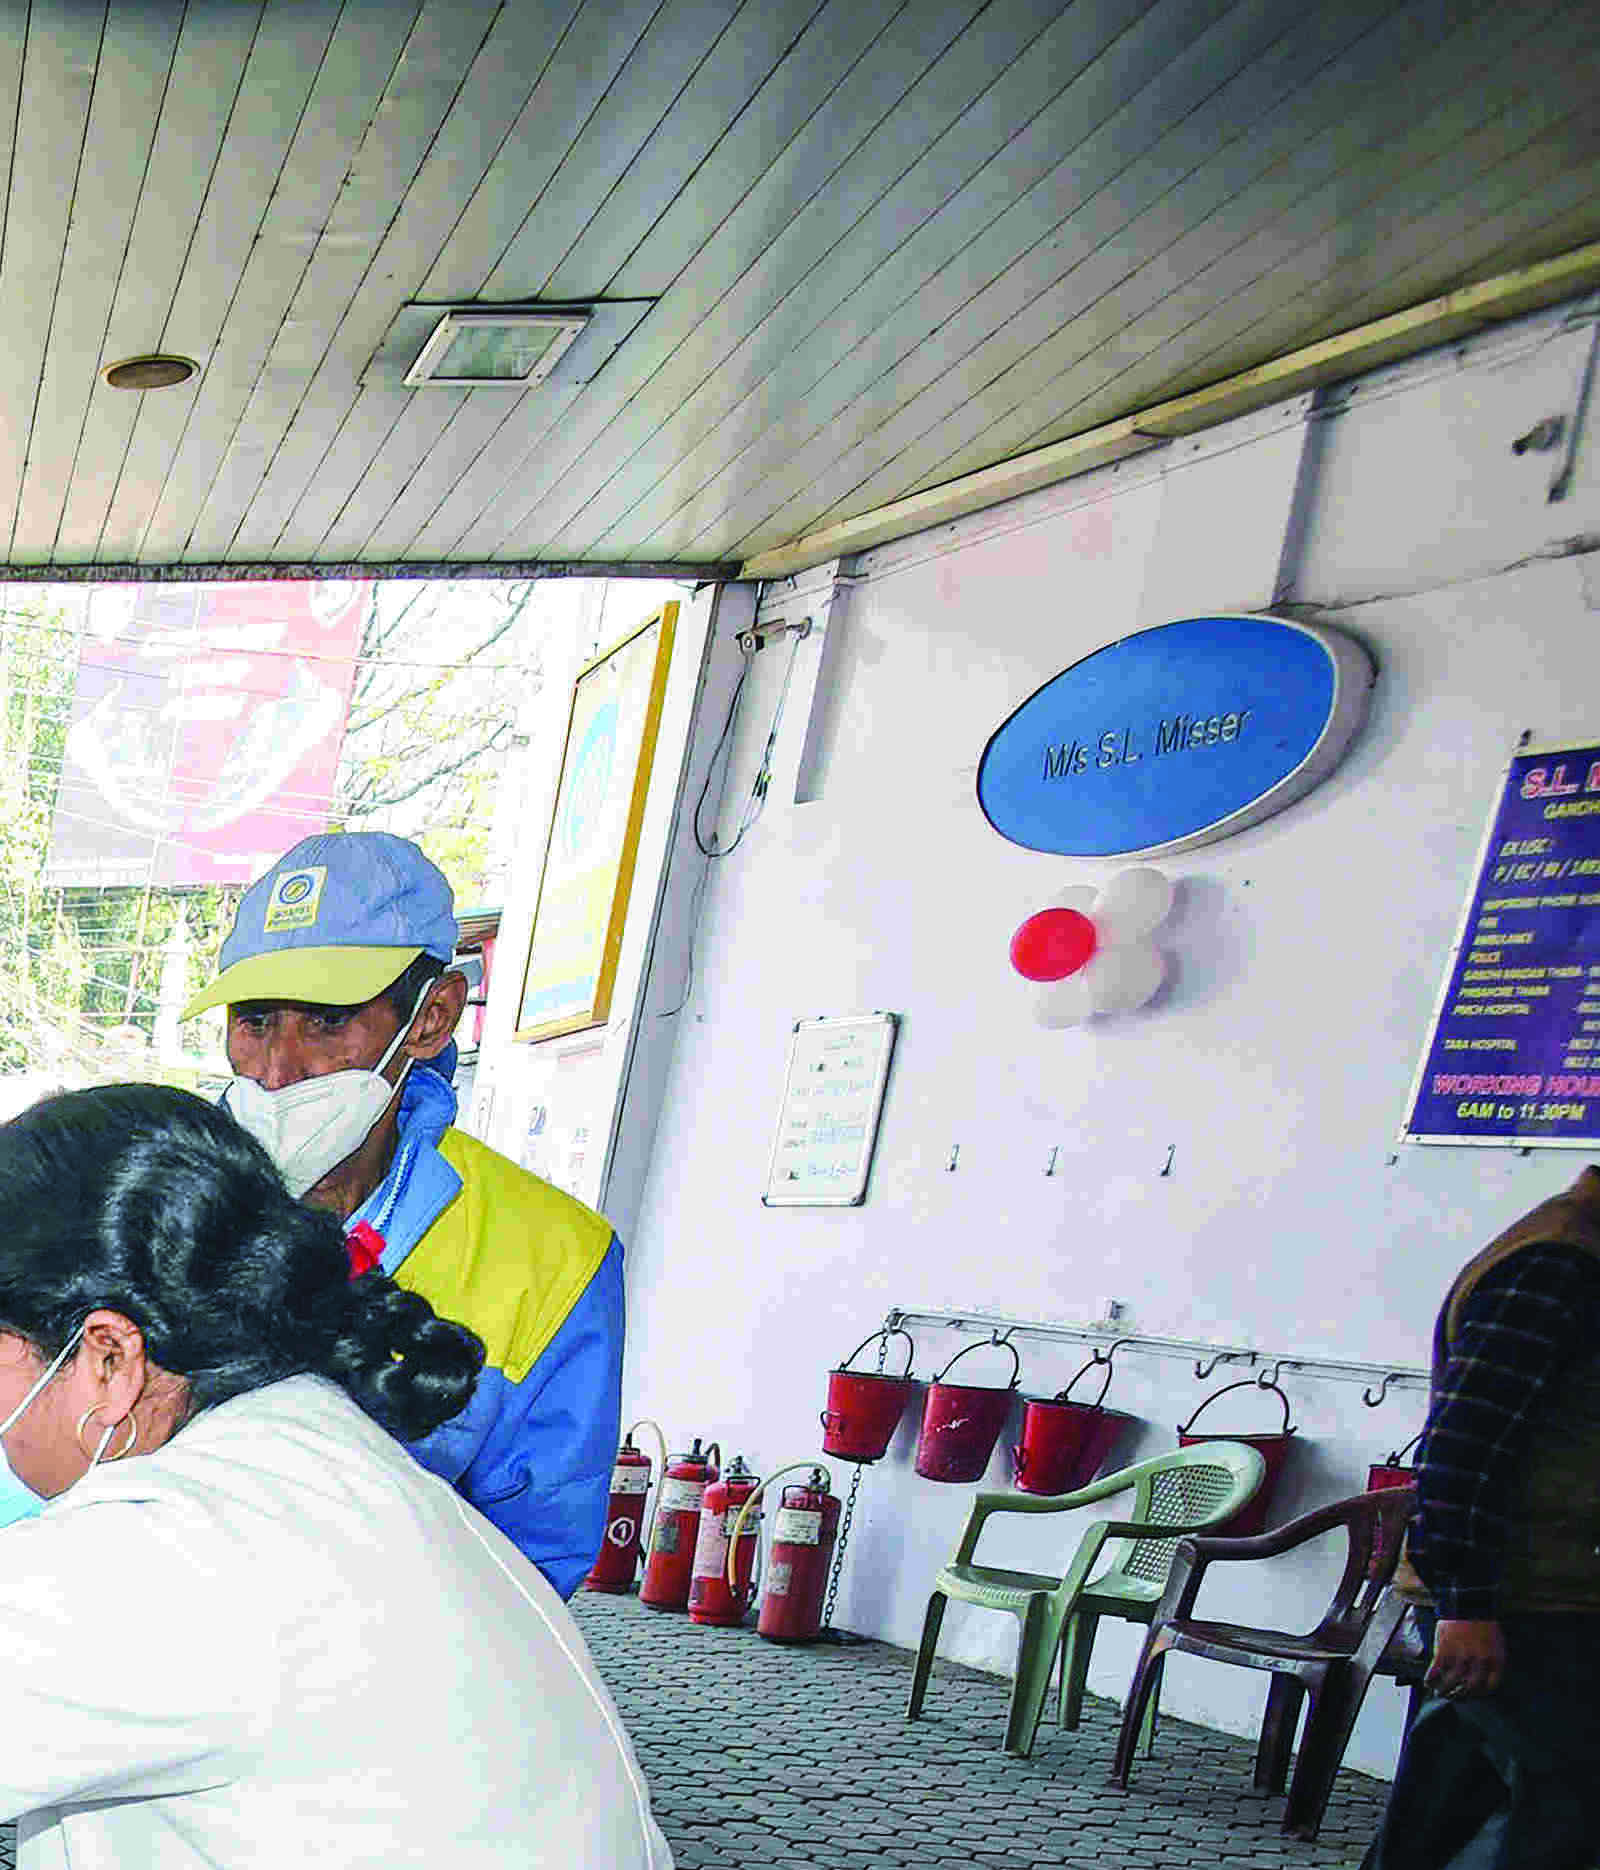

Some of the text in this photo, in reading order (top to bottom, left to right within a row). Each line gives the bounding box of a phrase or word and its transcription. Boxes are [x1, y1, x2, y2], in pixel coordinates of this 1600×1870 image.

[1043, 706, 1253, 781] M/s S.L. Misser
[1433, 1074, 1543, 1096] WORKING
[1456, 1102, 1495, 1119] 6AM
[1497, 1104, 1515, 1119] to
